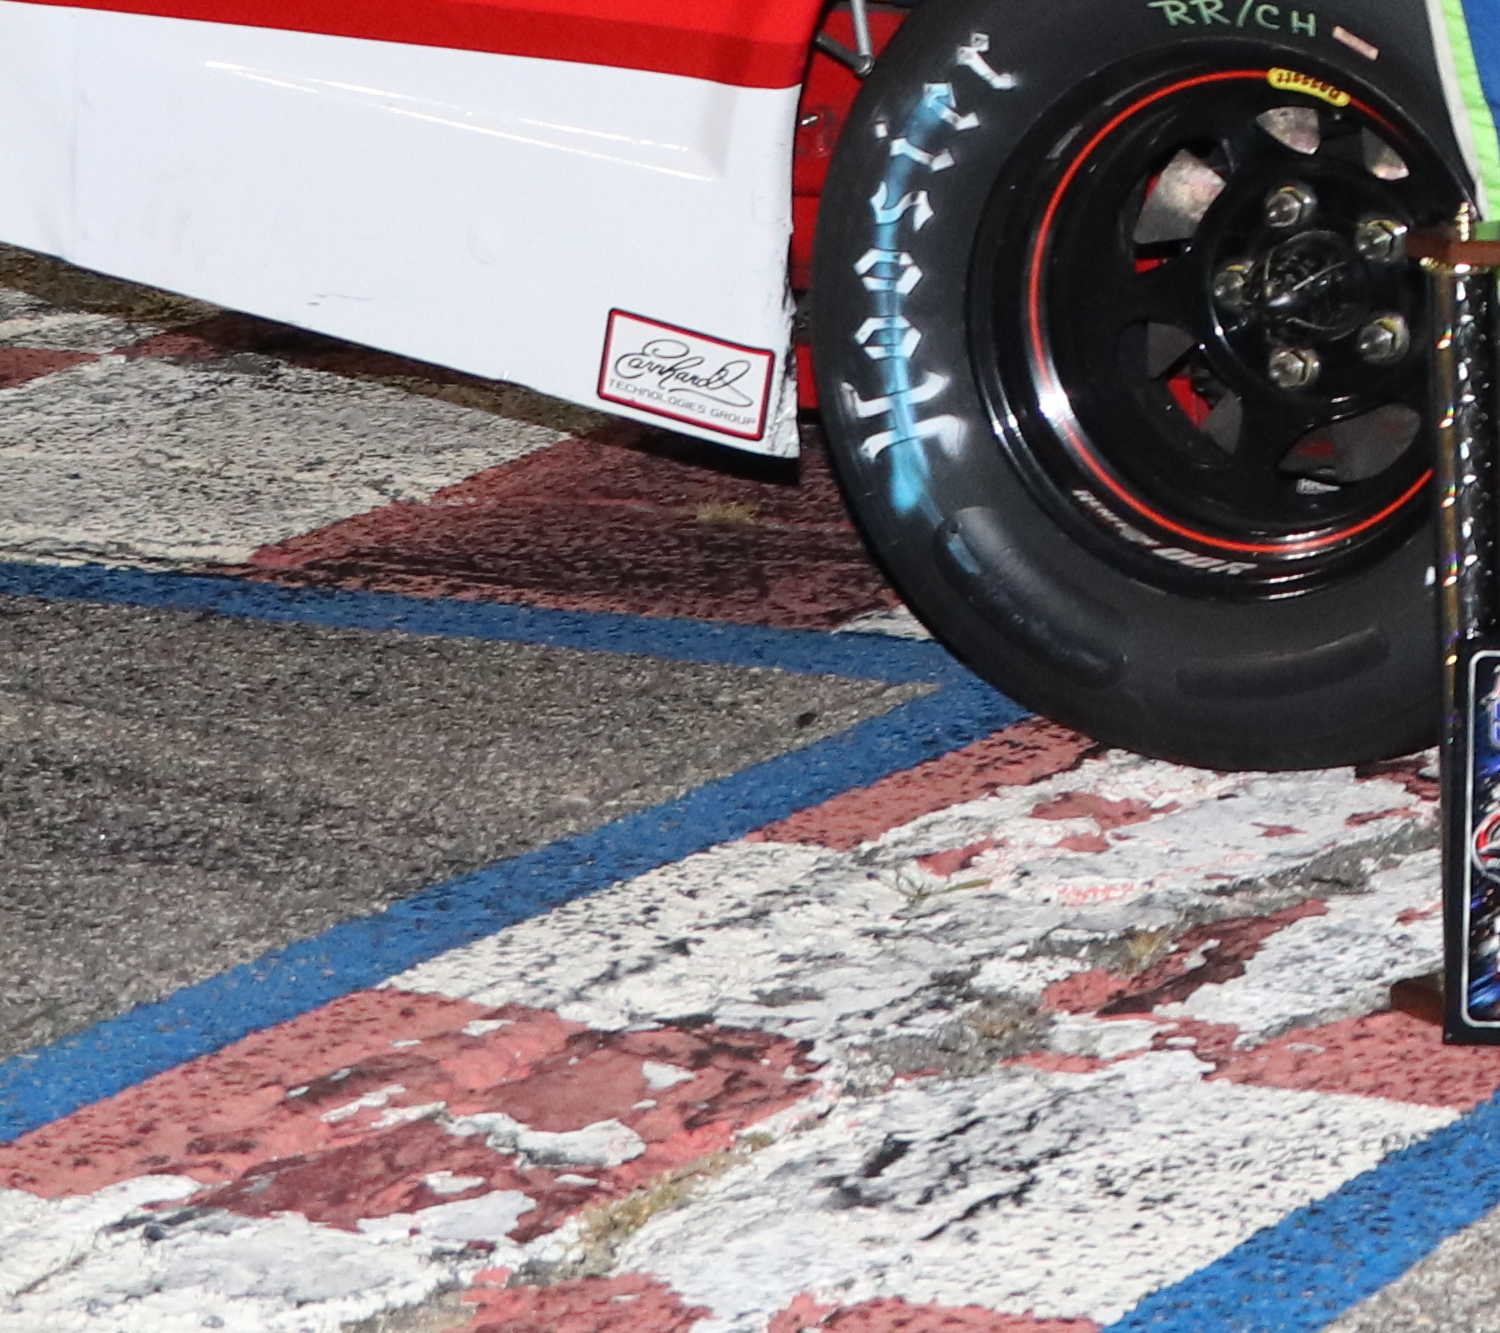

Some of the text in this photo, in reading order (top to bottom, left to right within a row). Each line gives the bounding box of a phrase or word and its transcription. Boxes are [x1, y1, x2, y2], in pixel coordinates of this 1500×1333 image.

[839, 30, 1024, 463] Hoosier
[607, 377, 757, 427] TECHNOLOGIES GROUP
